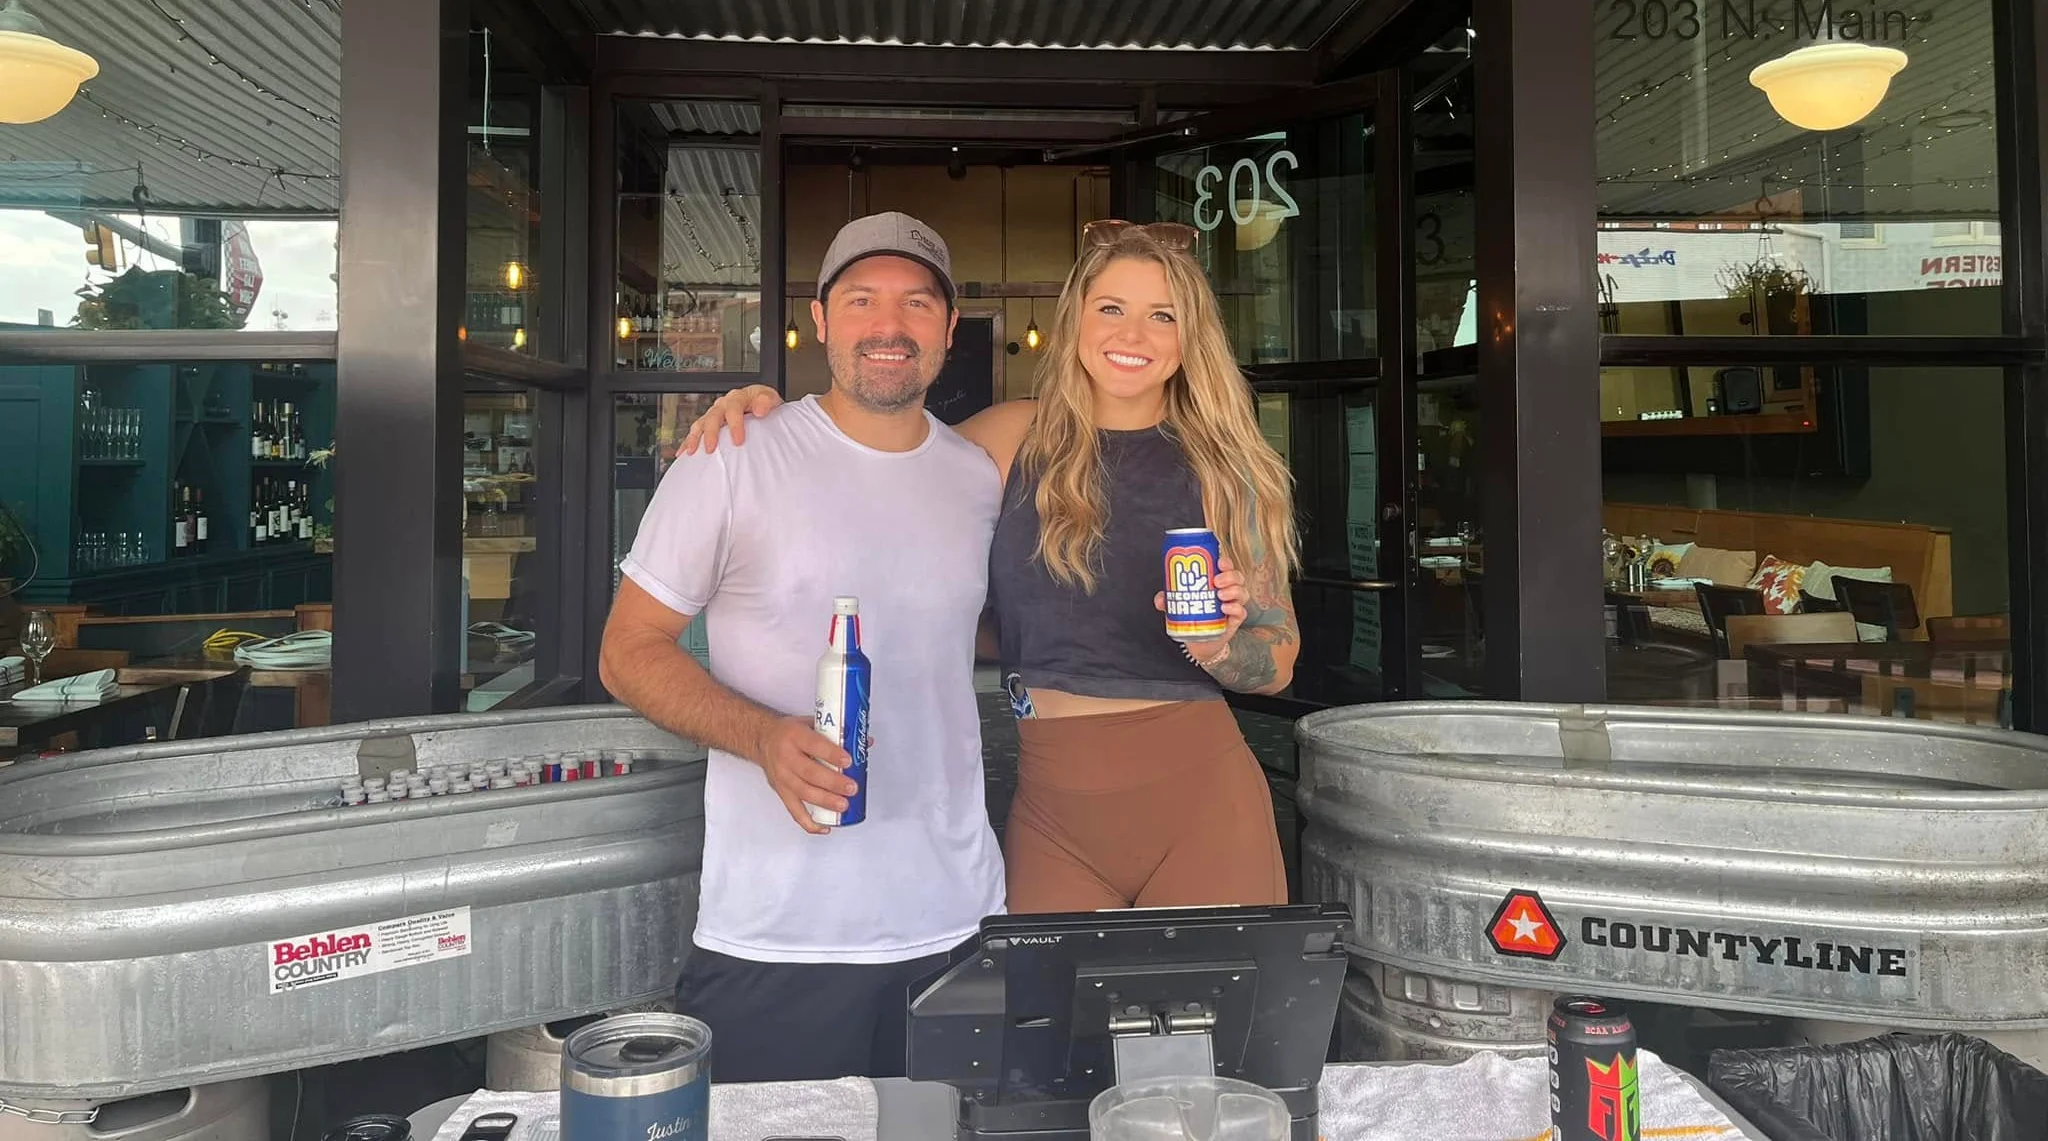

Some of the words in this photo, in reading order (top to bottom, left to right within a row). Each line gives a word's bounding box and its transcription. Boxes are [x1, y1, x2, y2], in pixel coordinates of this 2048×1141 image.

[1610, 0, 1700, 41] 203
[1794, 0, 1907, 41] Main
[1167, 600, 1216, 615] HAZE
[273, 932, 372, 965] Behlen
[1022, 936, 1062, 944] VAULT
[274, 948, 372, 981] COUNTRY
[647, 1116, 690, 1141] Justin
